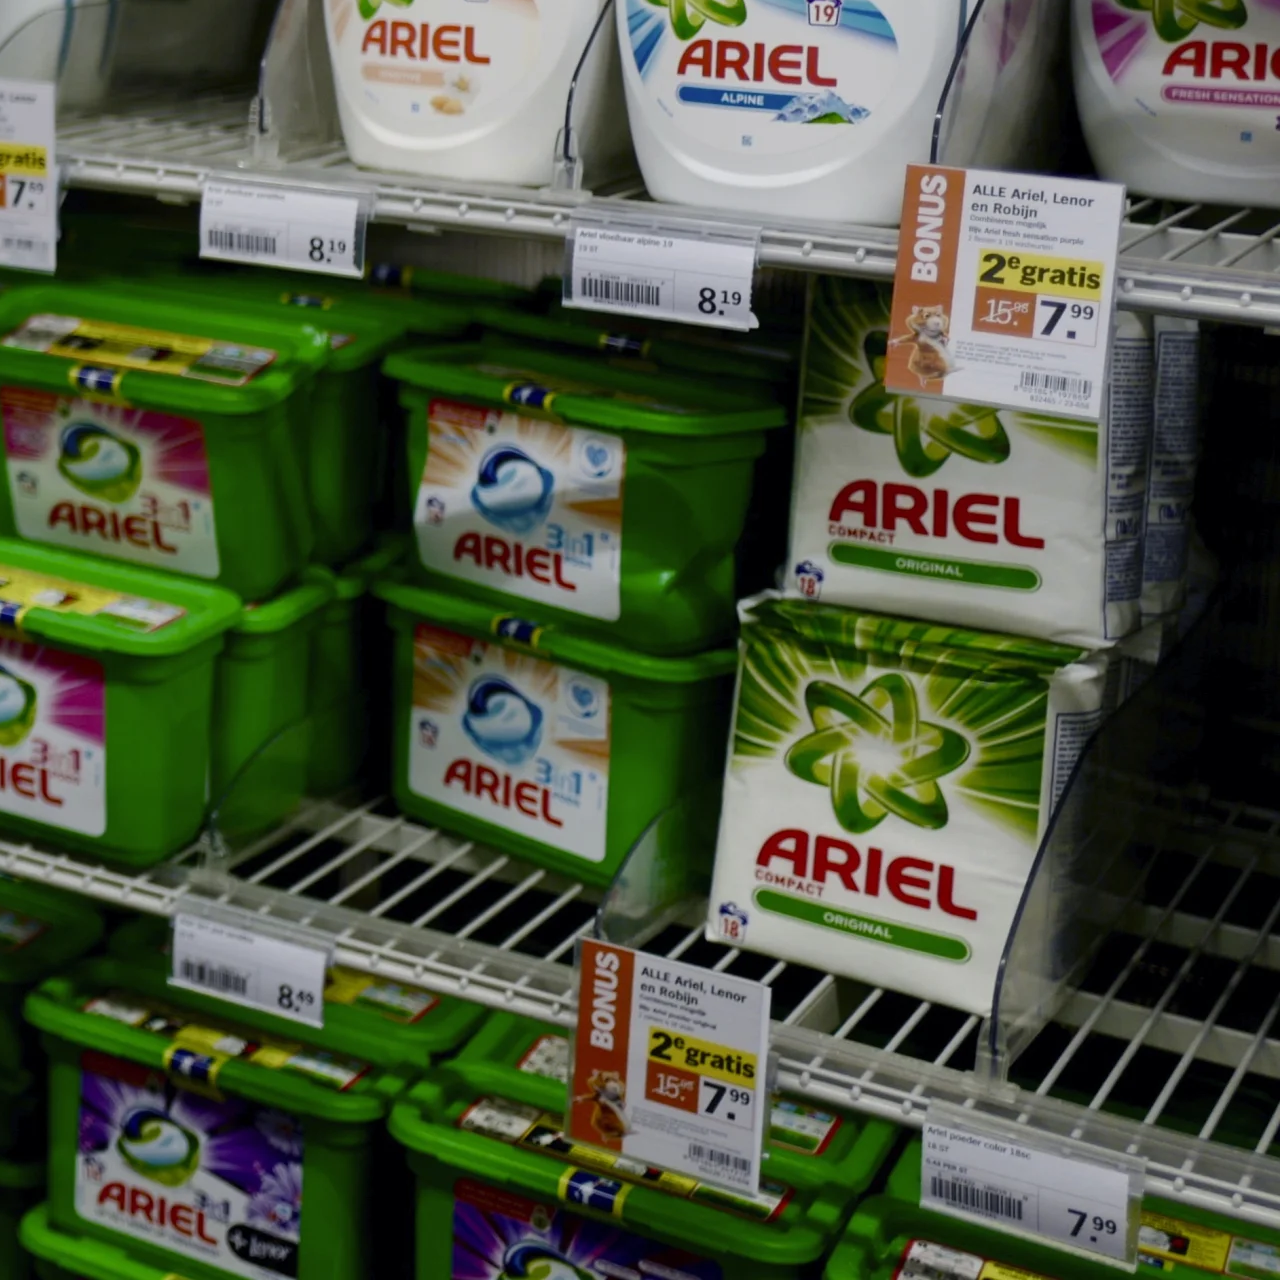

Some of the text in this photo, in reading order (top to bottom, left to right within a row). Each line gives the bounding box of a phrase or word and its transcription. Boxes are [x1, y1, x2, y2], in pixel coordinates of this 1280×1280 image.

[813, 4, 836, 23] 19
[361, 19, 491, 65] ARIEL
[677, 38, 838, 87] ARIEL
[1162, 39, 1280, 81] ARI
[720, 92, 765, 107] ALPINE
[1171, 87, 1280, 105] FRESH SENSATION
[971, 202, 1039, 220] en Robijn
[972, 183, 1096, 208] ALLE Ariel, Lenor
[910, 173, 948, 284] BONUS
[984, 226, 1002, 236] Ariel
[1002, 228, 1021, 238] fresh
[1022, 231, 1058, 243] sensation
[308, 236, 346, 264] 8.19
[1019, 265, 1101, 291] gratis
[697, 286, 742, 317] 8.19
[1040, 300, 1095, 340] 7.99
[47, 501, 179, 555] ARIEL
[829, 479, 1046, 550] ARIEL
[827, 523, 897, 545] COMPACT
[453, 531, 577, 592] ARIEL
[894, 556, 964, 578] ORIGINAL
[797, 575, 817, 598] 18
[443, 757, 564, 829] ARIEL
[754, 869, 826, 899] COMPACT
[755, 828, 978, 922] ARIEL
[722, 917, 740, 940] 18
[822, 910, 894, 940] ORIGINAL
[640, 966, 748, 1004] ALLE Ariel, Lenor
[640, 982, 699, 1006] en Robijn
[590, 951, 620, 1052] BONUS
[685, 1045, 756, 1080] gratis
[703, 1080, 751, 1121] 7.99
[927, 1125, 1008, 1154] Ariel poeder color
[97, 1181, 219, 1246] ARIEL
[1067, 1207, 1118, 1244] 7.99
